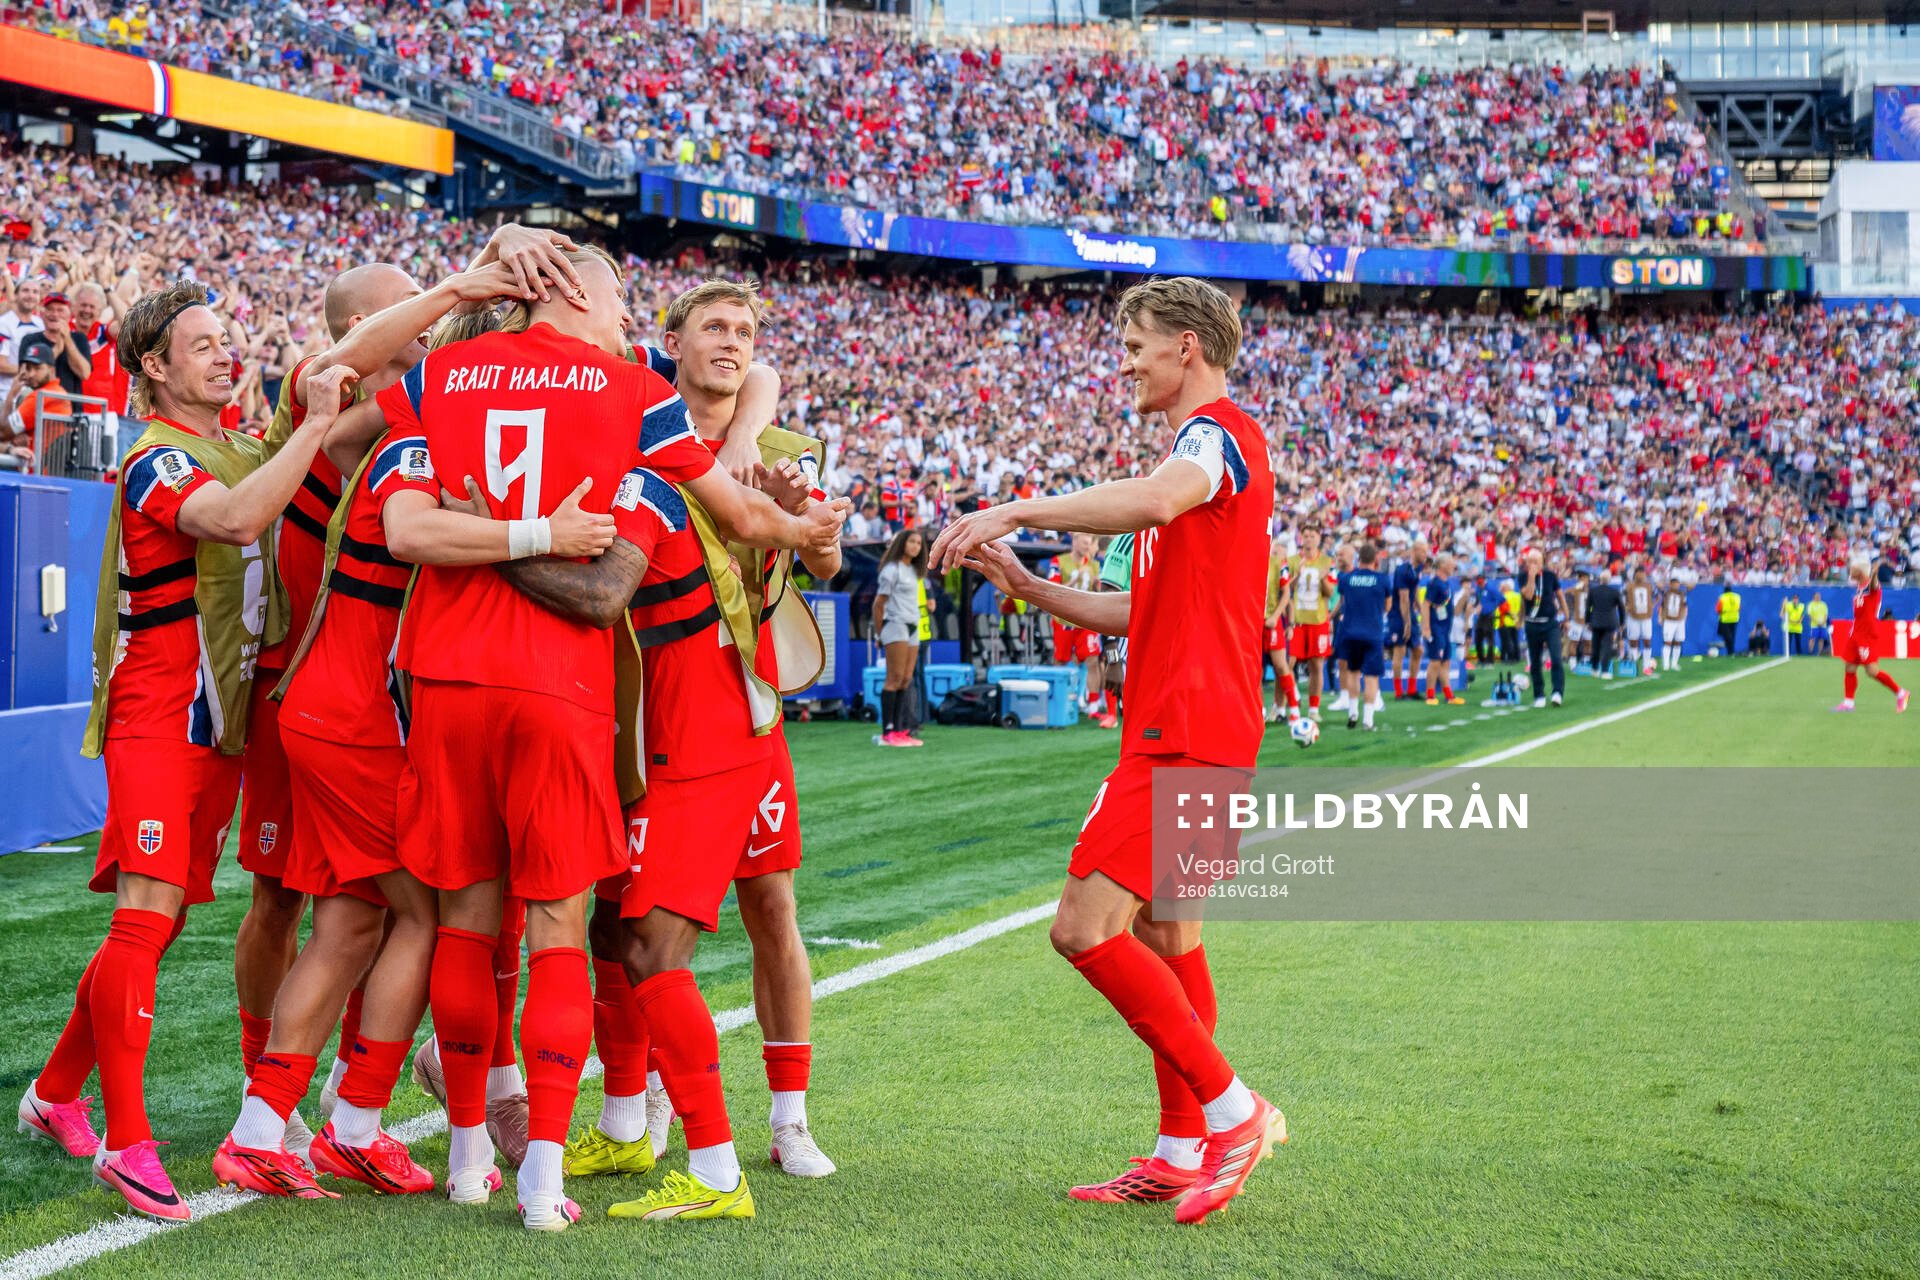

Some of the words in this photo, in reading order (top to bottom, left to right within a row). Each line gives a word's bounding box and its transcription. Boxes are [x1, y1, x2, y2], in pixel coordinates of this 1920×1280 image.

[701, 190, 755, 225] STON
[1612, 258, 1704, 285] STON
[444, 364, 506, 395] BRAUT
[508, 365, 608, 393] HAALAND
[484, 408, 547, 521] 9
